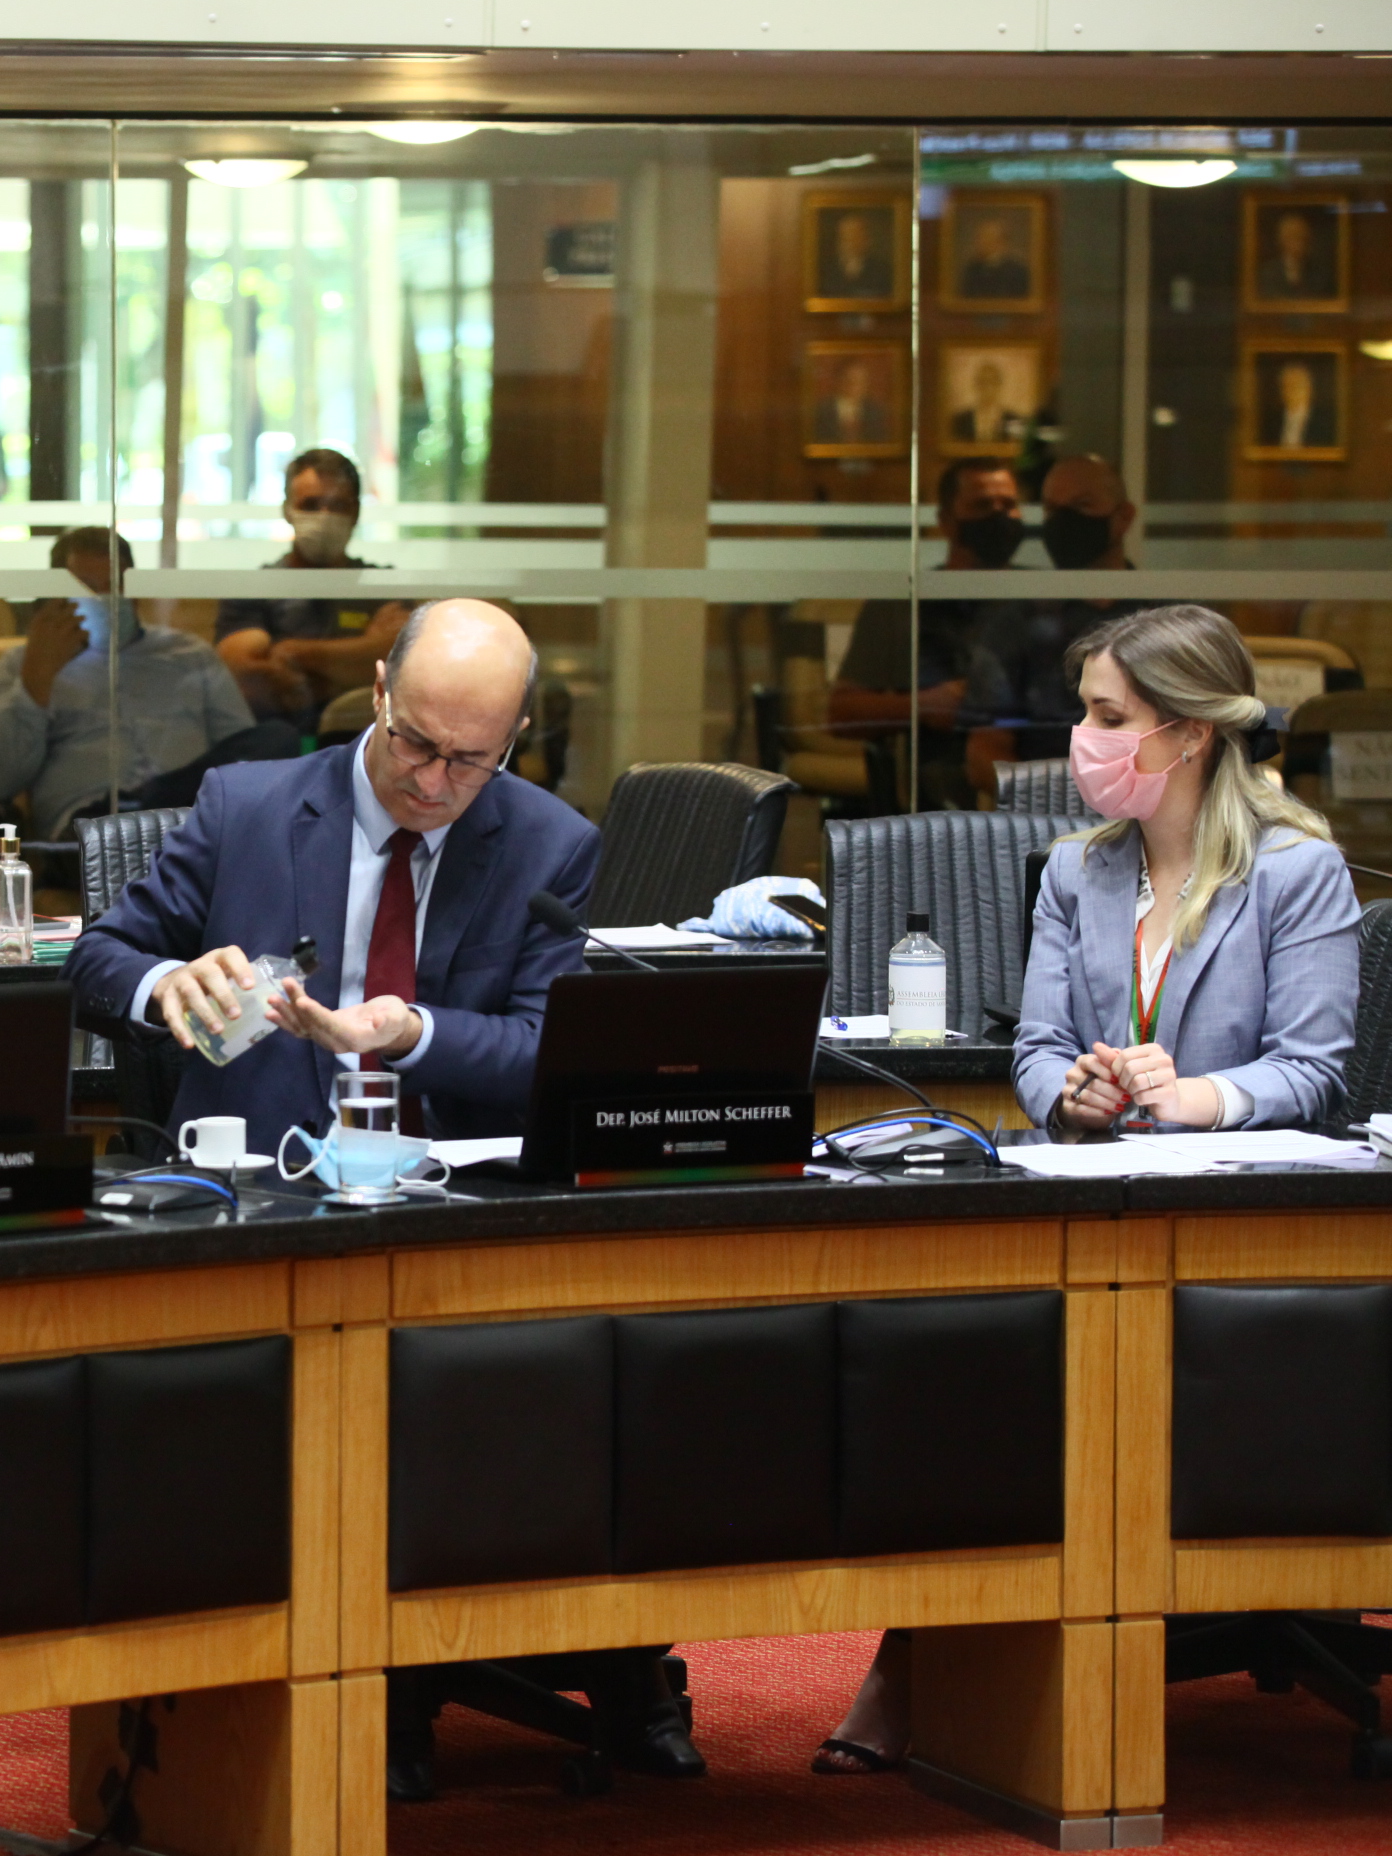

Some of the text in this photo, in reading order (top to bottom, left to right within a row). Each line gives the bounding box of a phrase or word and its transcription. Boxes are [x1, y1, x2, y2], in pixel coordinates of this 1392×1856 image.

[896, 990, 937, 998] ASSEMBLEIA
[596, 1105, 793, 1128] DEP. JOSÉ MILTON SCHEFFER
